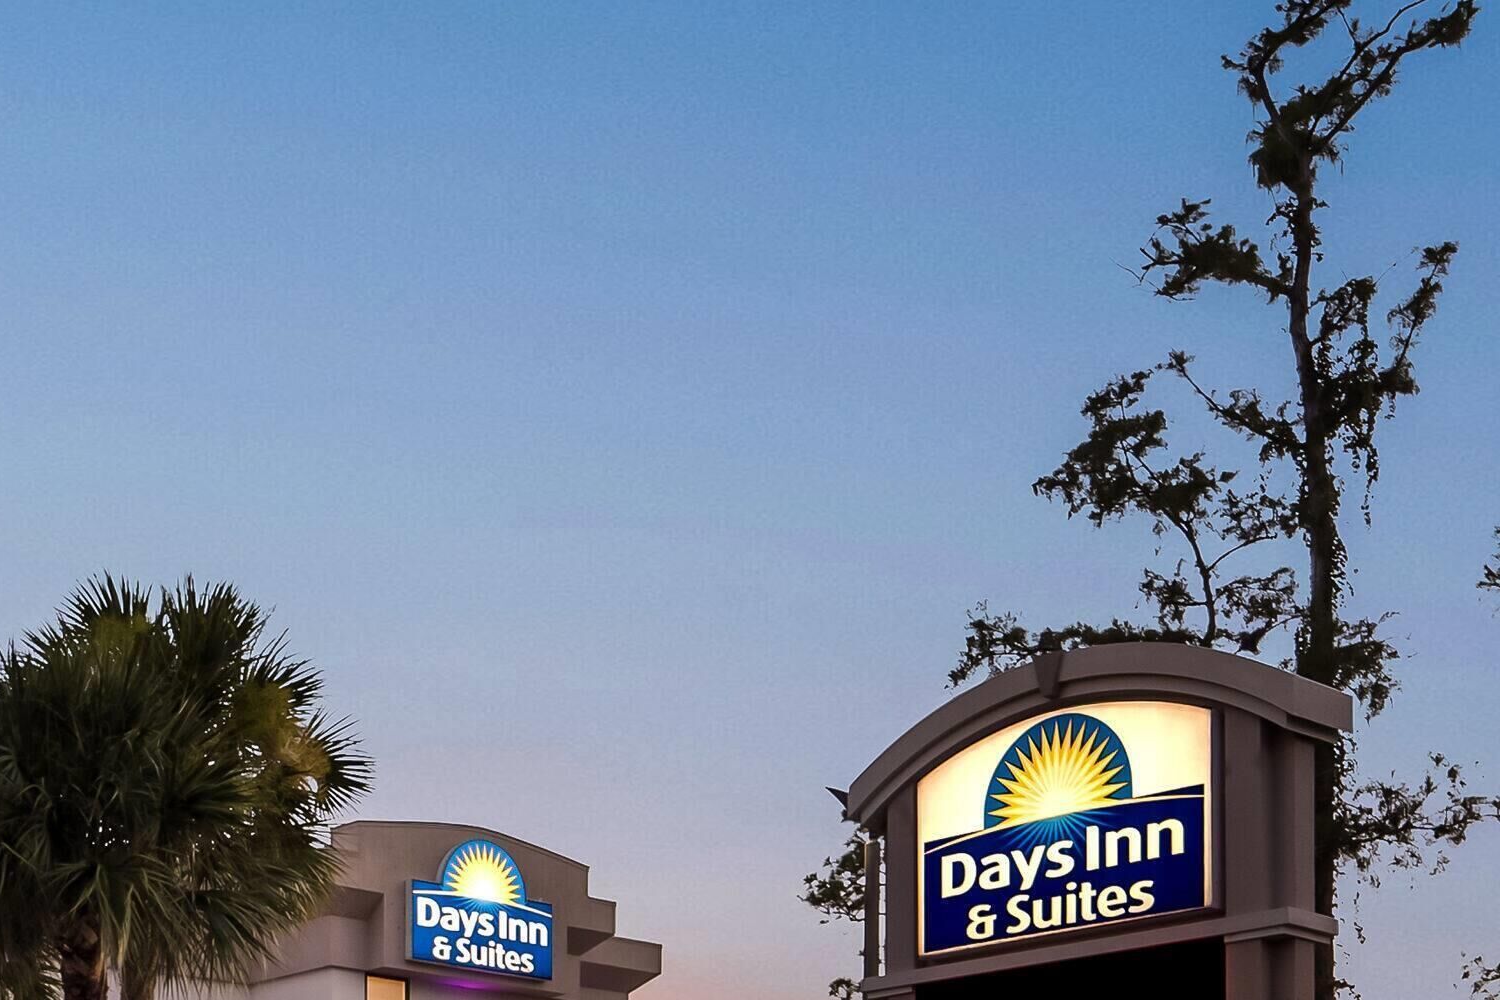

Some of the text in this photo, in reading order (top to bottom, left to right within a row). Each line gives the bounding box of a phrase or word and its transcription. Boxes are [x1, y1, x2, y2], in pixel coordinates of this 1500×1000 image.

[940, 818, 1185, 899] Days Inn
[415, 896, 548, 947] Days Inn
[965, 879, 1155, 940] & Suites
[432, 936, 534, 973] & Suites
